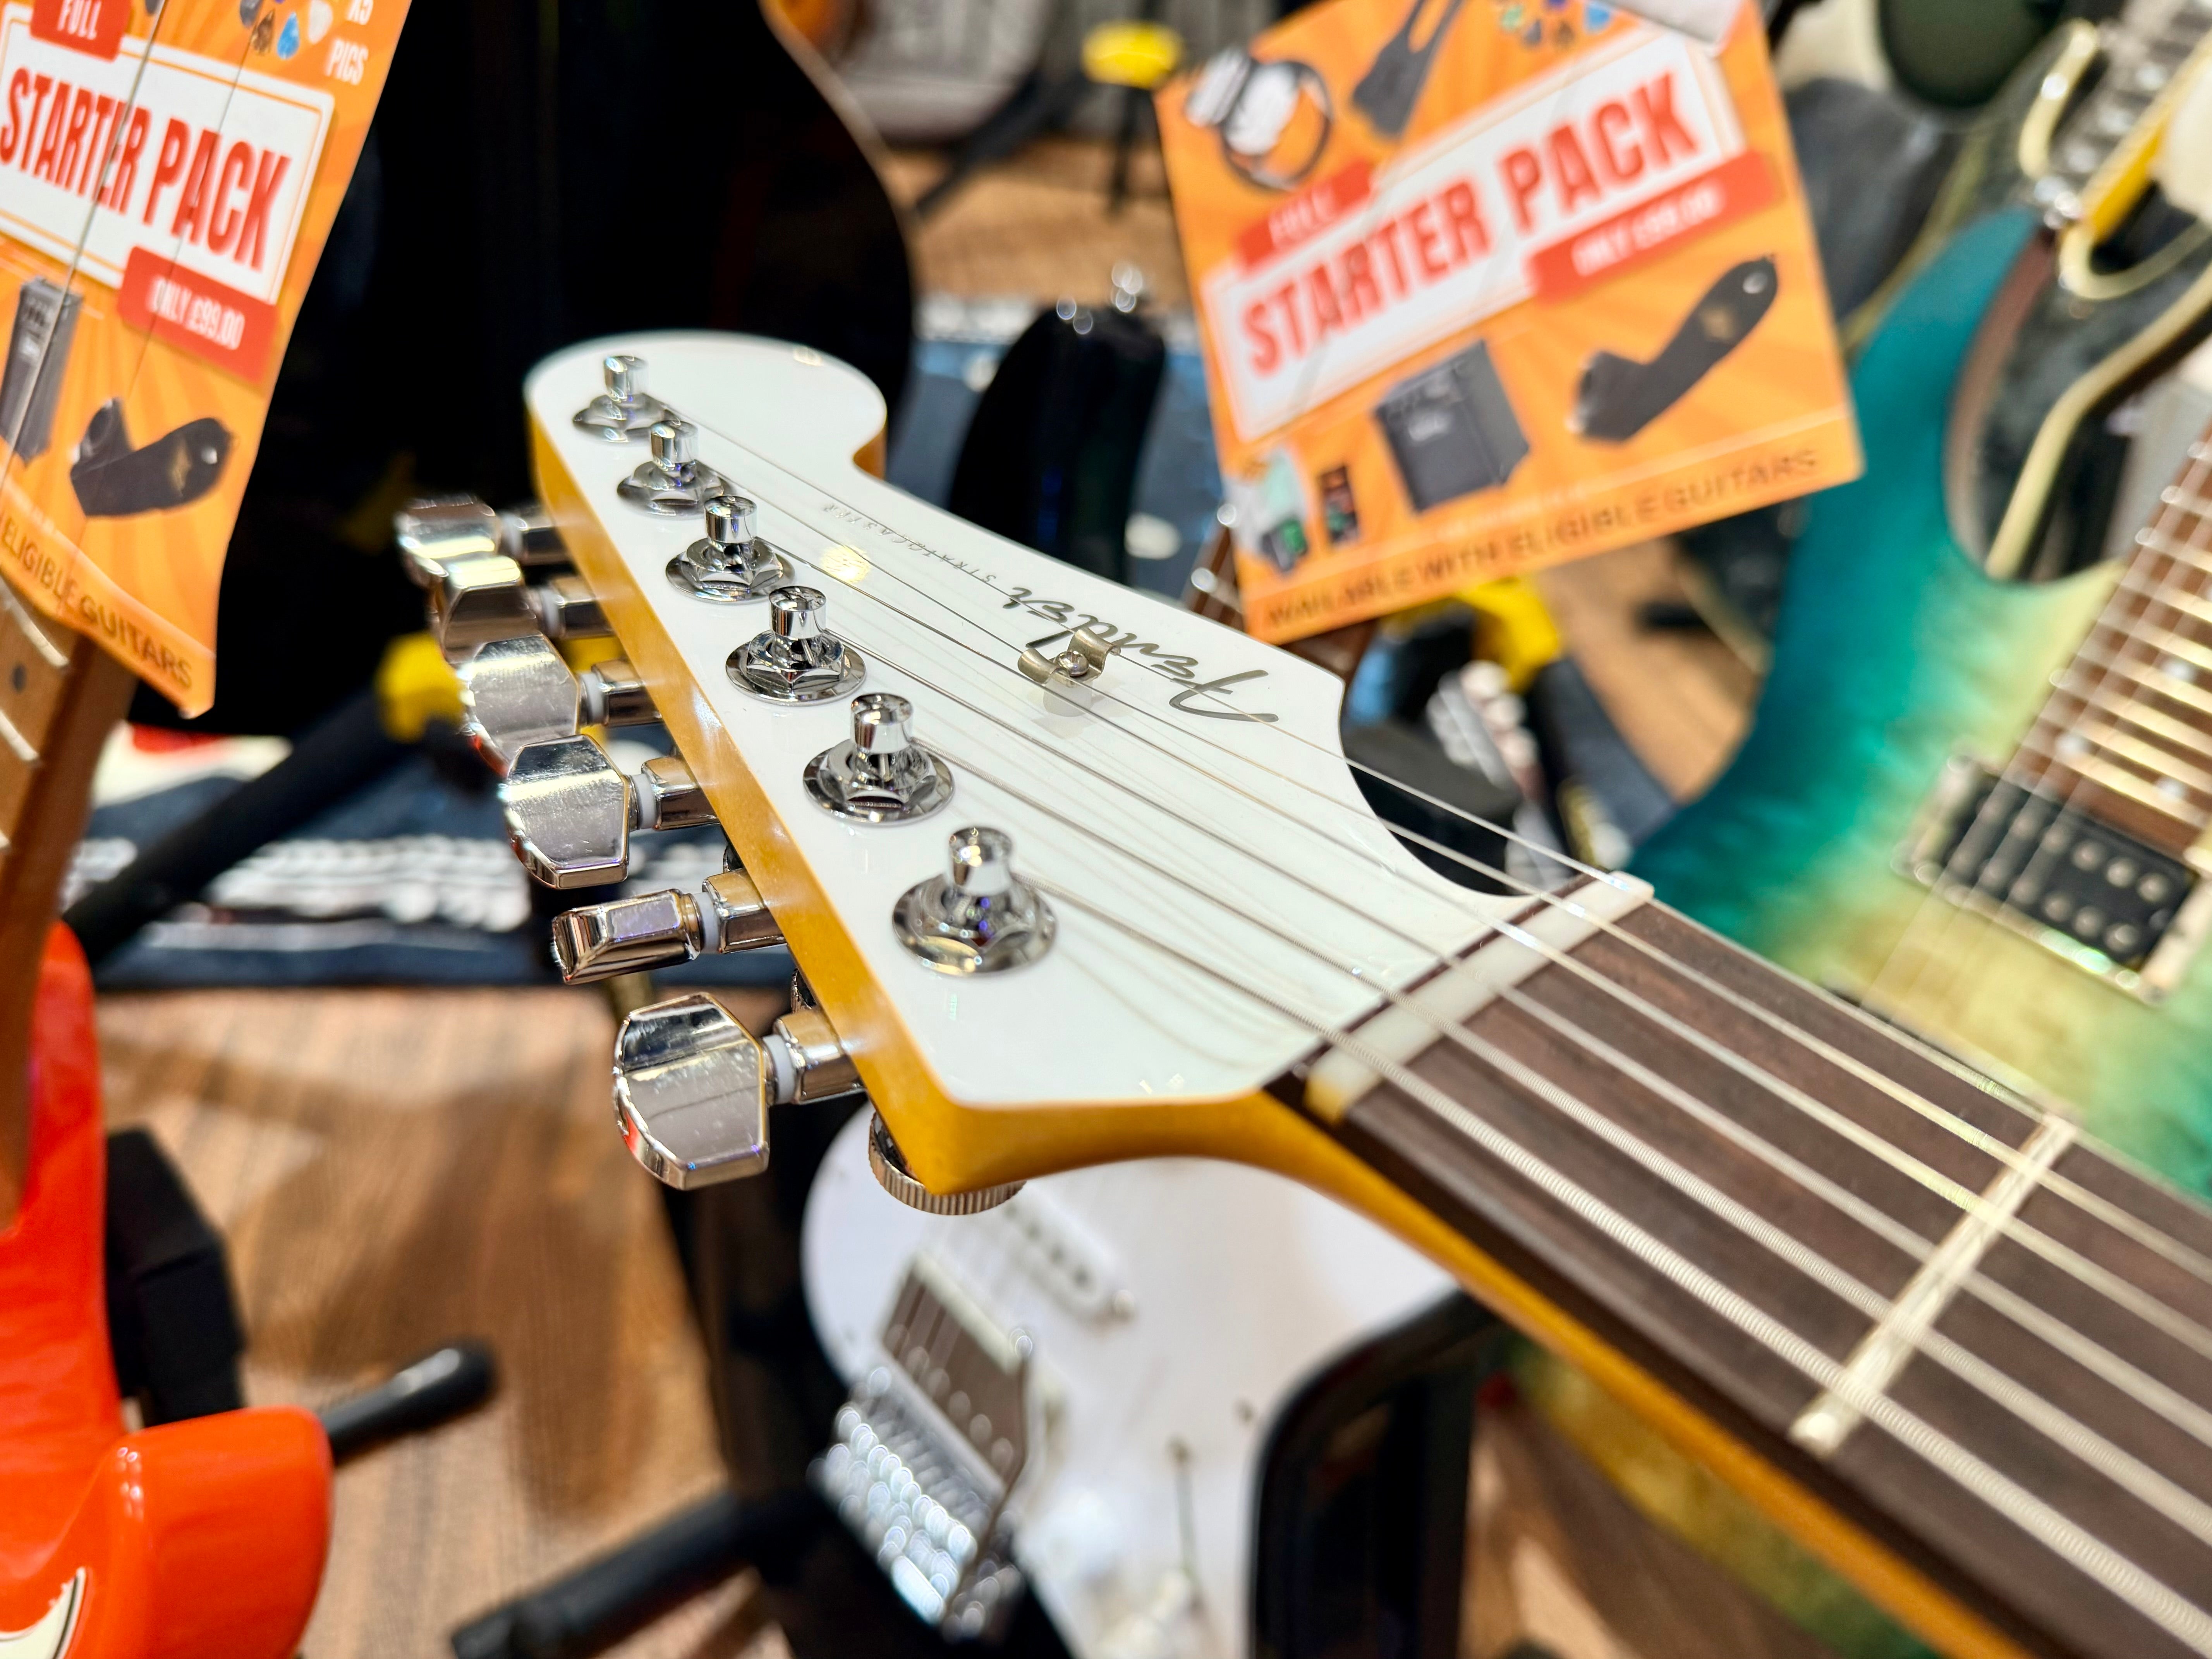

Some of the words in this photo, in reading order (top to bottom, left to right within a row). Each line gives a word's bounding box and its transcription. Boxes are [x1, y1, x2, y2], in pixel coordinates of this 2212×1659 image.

[57, 0, 102, 40] FULL
[325, 38, 369, 86] PICS
[0, 67, 152, 216] STARTER
[143, 117, 292, 273] PACK
[1496, 70, 1698, 235] PACK
[148, 275, 193, 325] ONLY
[185, 295, 246, 350] £99.00
[1242, 180, 1492, 378] STARTER
[1417, 541, 1499, 582] WITH
[1508, 494, 1659, 558] ELIGIBLE
[1664, 448, 1817, 507] GUITARS
[2, 516, 79, 614] ELIGIBLE
[79, 595, 193, 689] GUITARS
[1002, 587, 1279, 723] Fender
